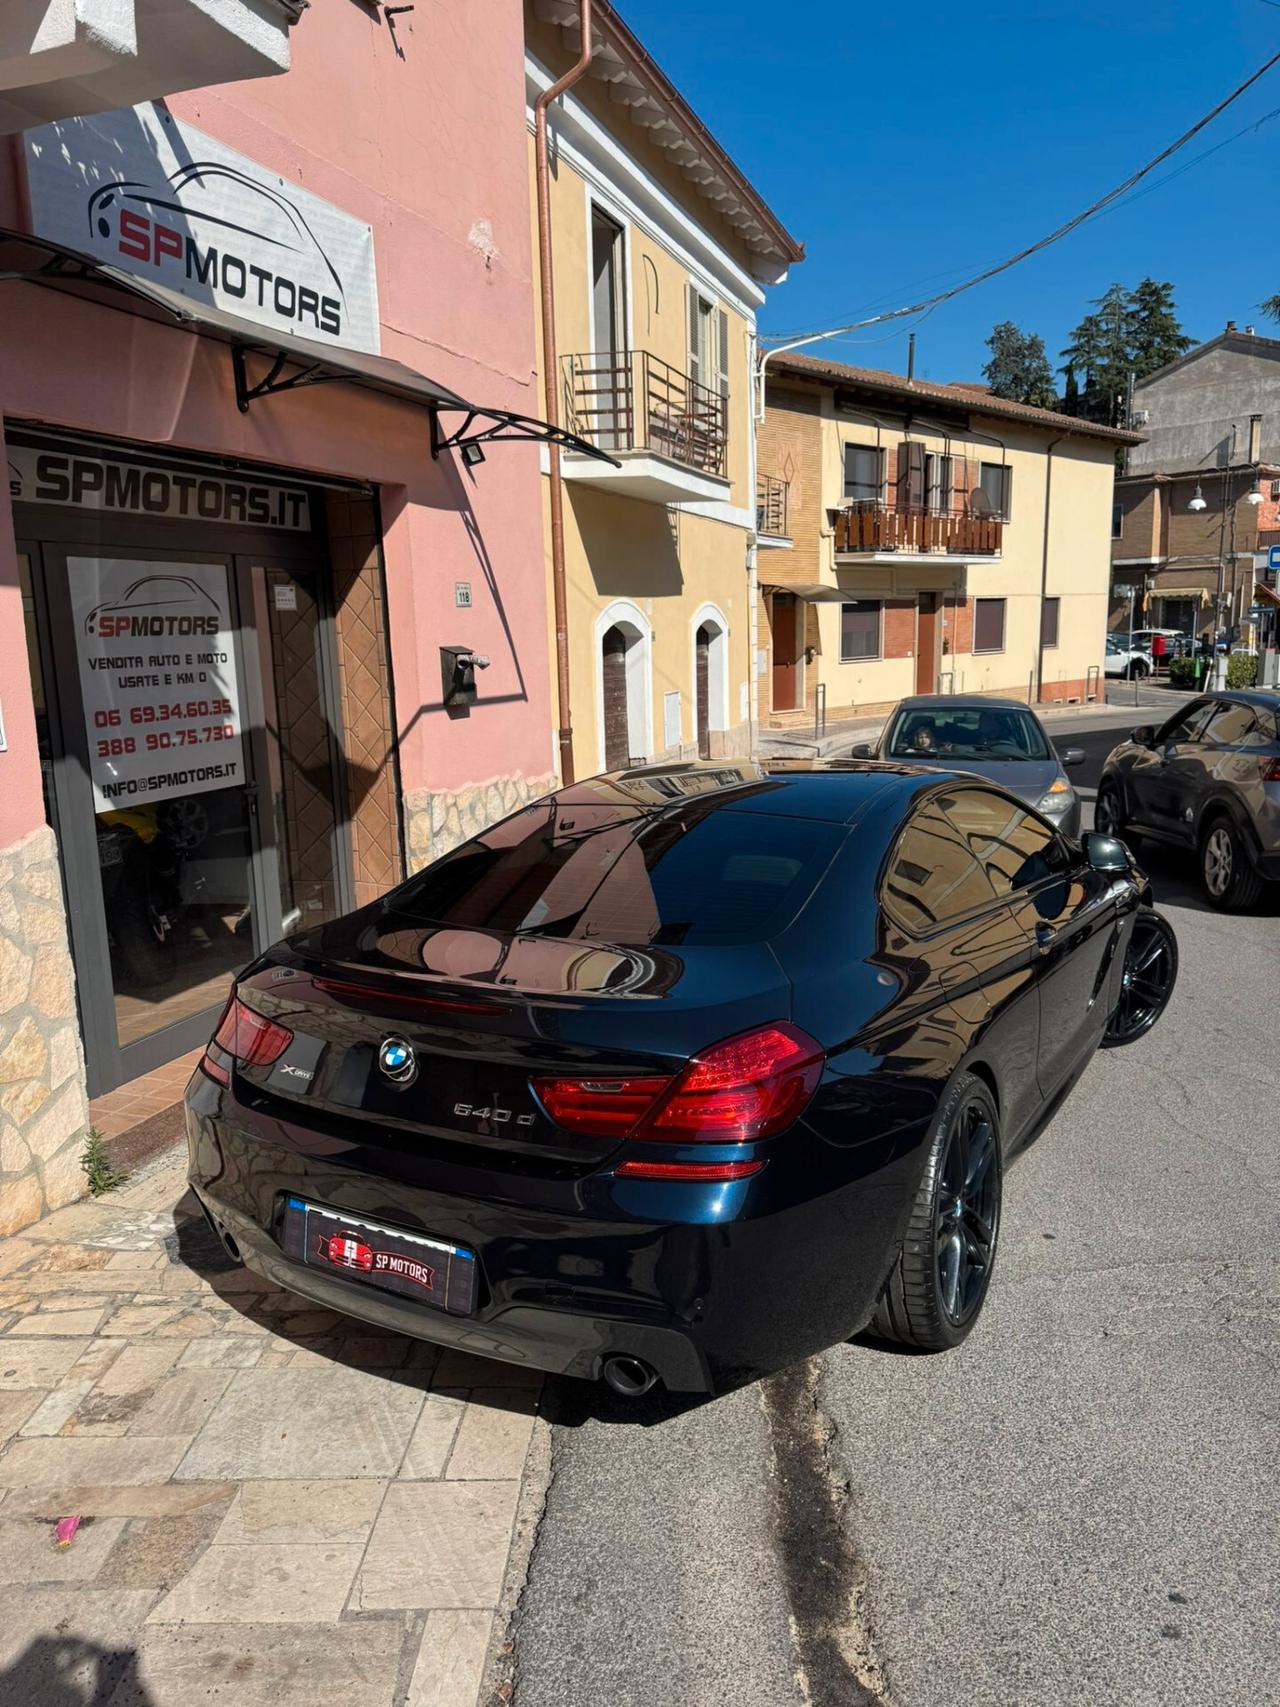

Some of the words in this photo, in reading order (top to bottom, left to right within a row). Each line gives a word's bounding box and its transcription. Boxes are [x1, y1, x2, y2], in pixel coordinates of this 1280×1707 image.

[118, 208, 341, 336] SPMOTORS
[36, 455, 307, 527] SPMOTORS.IT
[459, 592, 469, 602] 118
[98, 616, 219, 637] SPMOTORS
[88, 656, 143, 670] VENDITA
[149, 654, 180, 667] AUTO
[186, 654, 193, 665] E
[197, 653, 227, 665] MOTO
[118, 675, 159, 688] USATE
[164, 673, 171, 685] E
[177, 672, 194, 684] KM
[94, 709, 121, 728] 06
[130, 699, 232, 724] 69.34.60.35
[97, 736, 136, 757] 388
[146, 724, 234, 751] 90.75.730
[102, 762, 237, 799] INFO@SPMOTORS.IT
[454, 1102, 512, 1122] 640
[375, 1253, 389, 1269] SP
[389, 1256, 428, 1284] MOTORS
